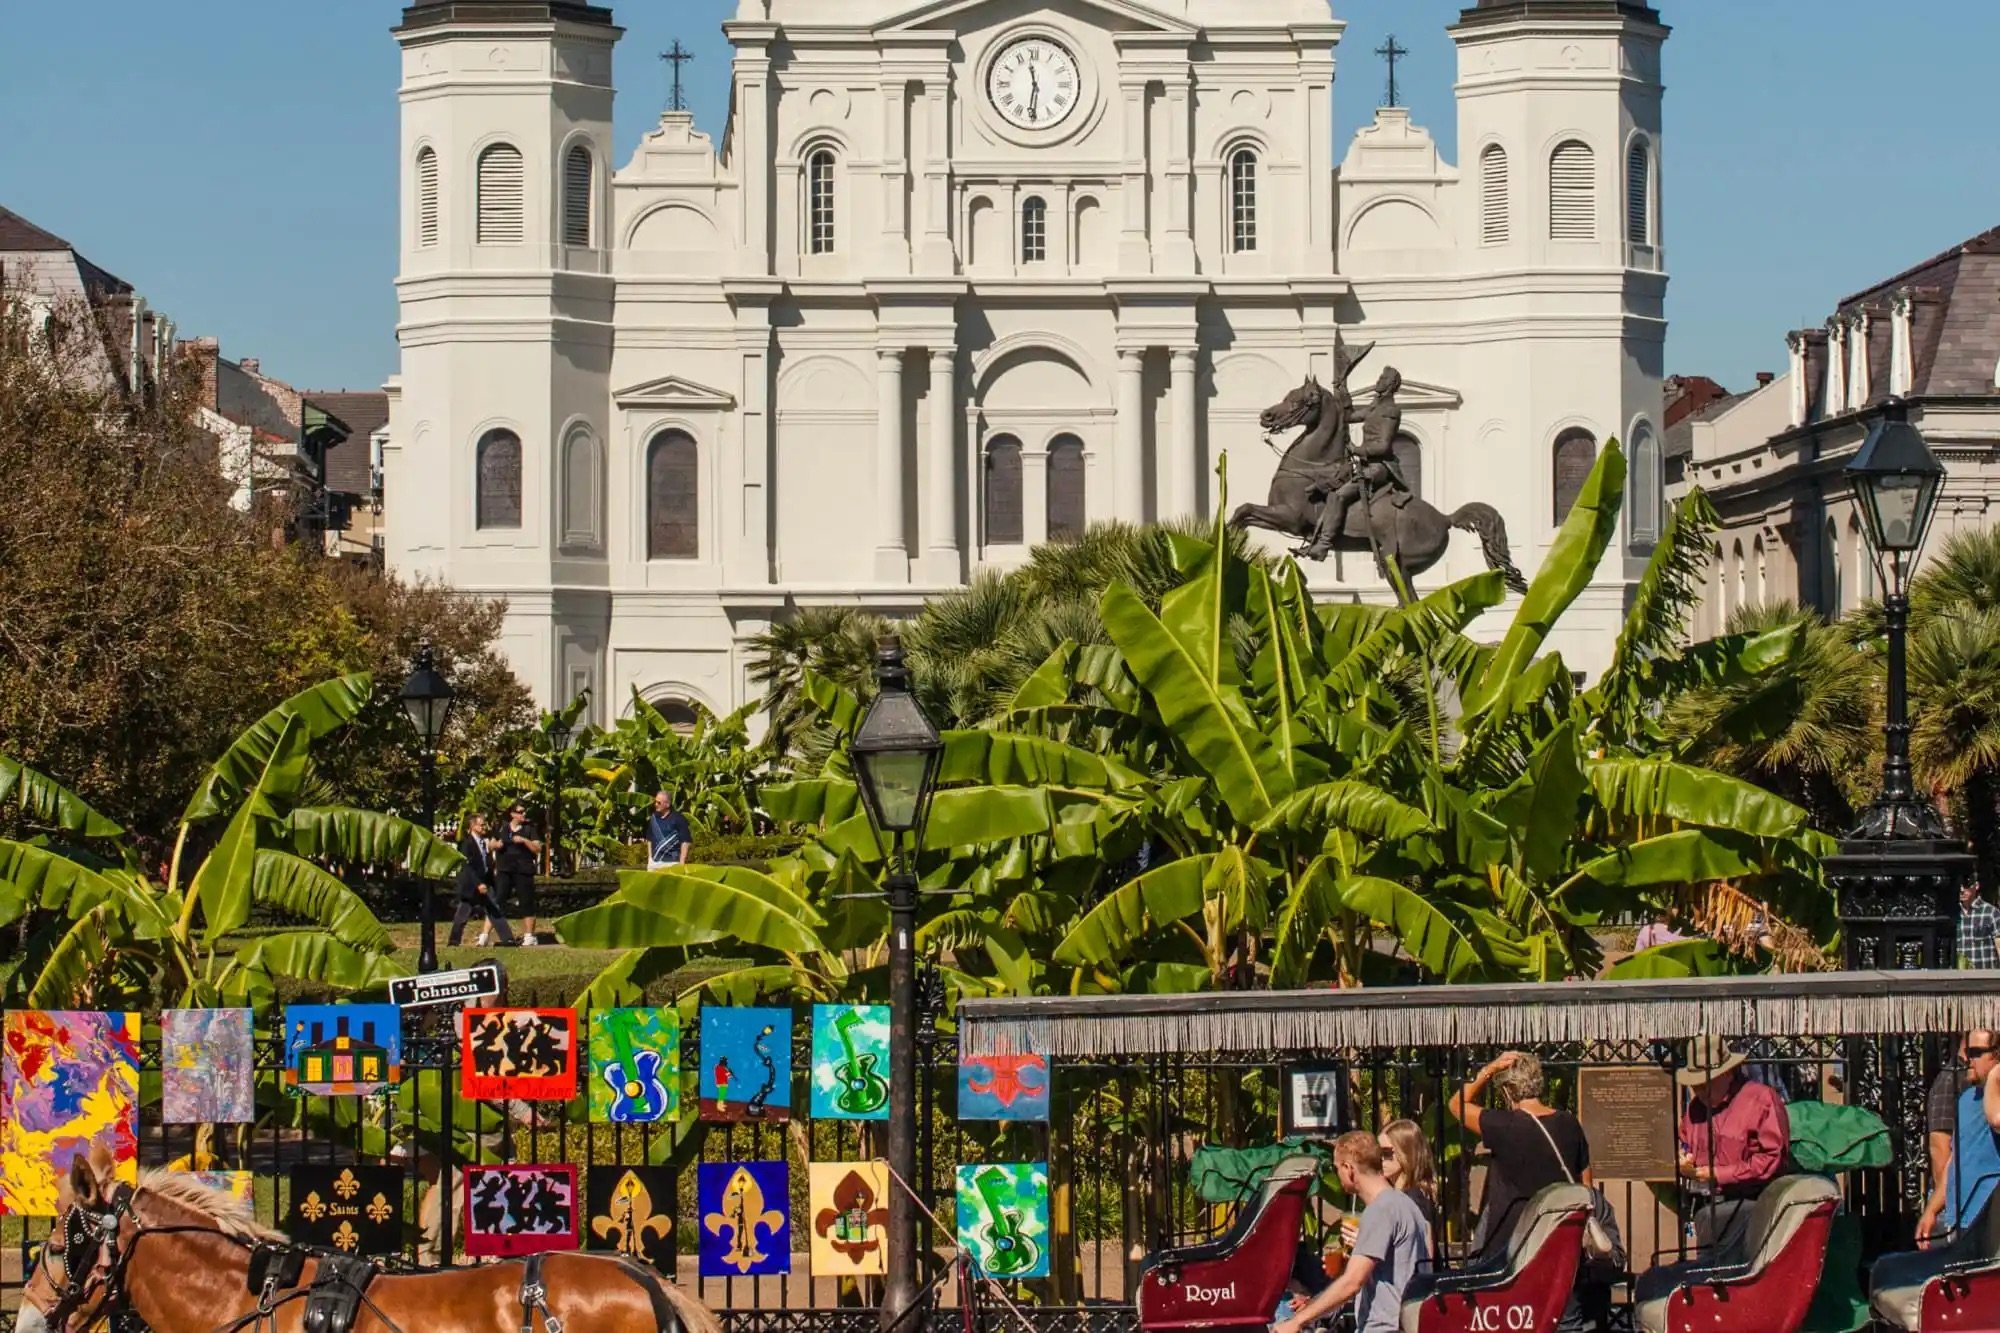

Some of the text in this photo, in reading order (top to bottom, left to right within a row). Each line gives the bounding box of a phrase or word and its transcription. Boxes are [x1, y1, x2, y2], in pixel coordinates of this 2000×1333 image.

[412, 982, 479, 1003] Johnson
[1184, 1280, 1236, 1306] Royal
[1469, 1304, 1501, 1332] AC
